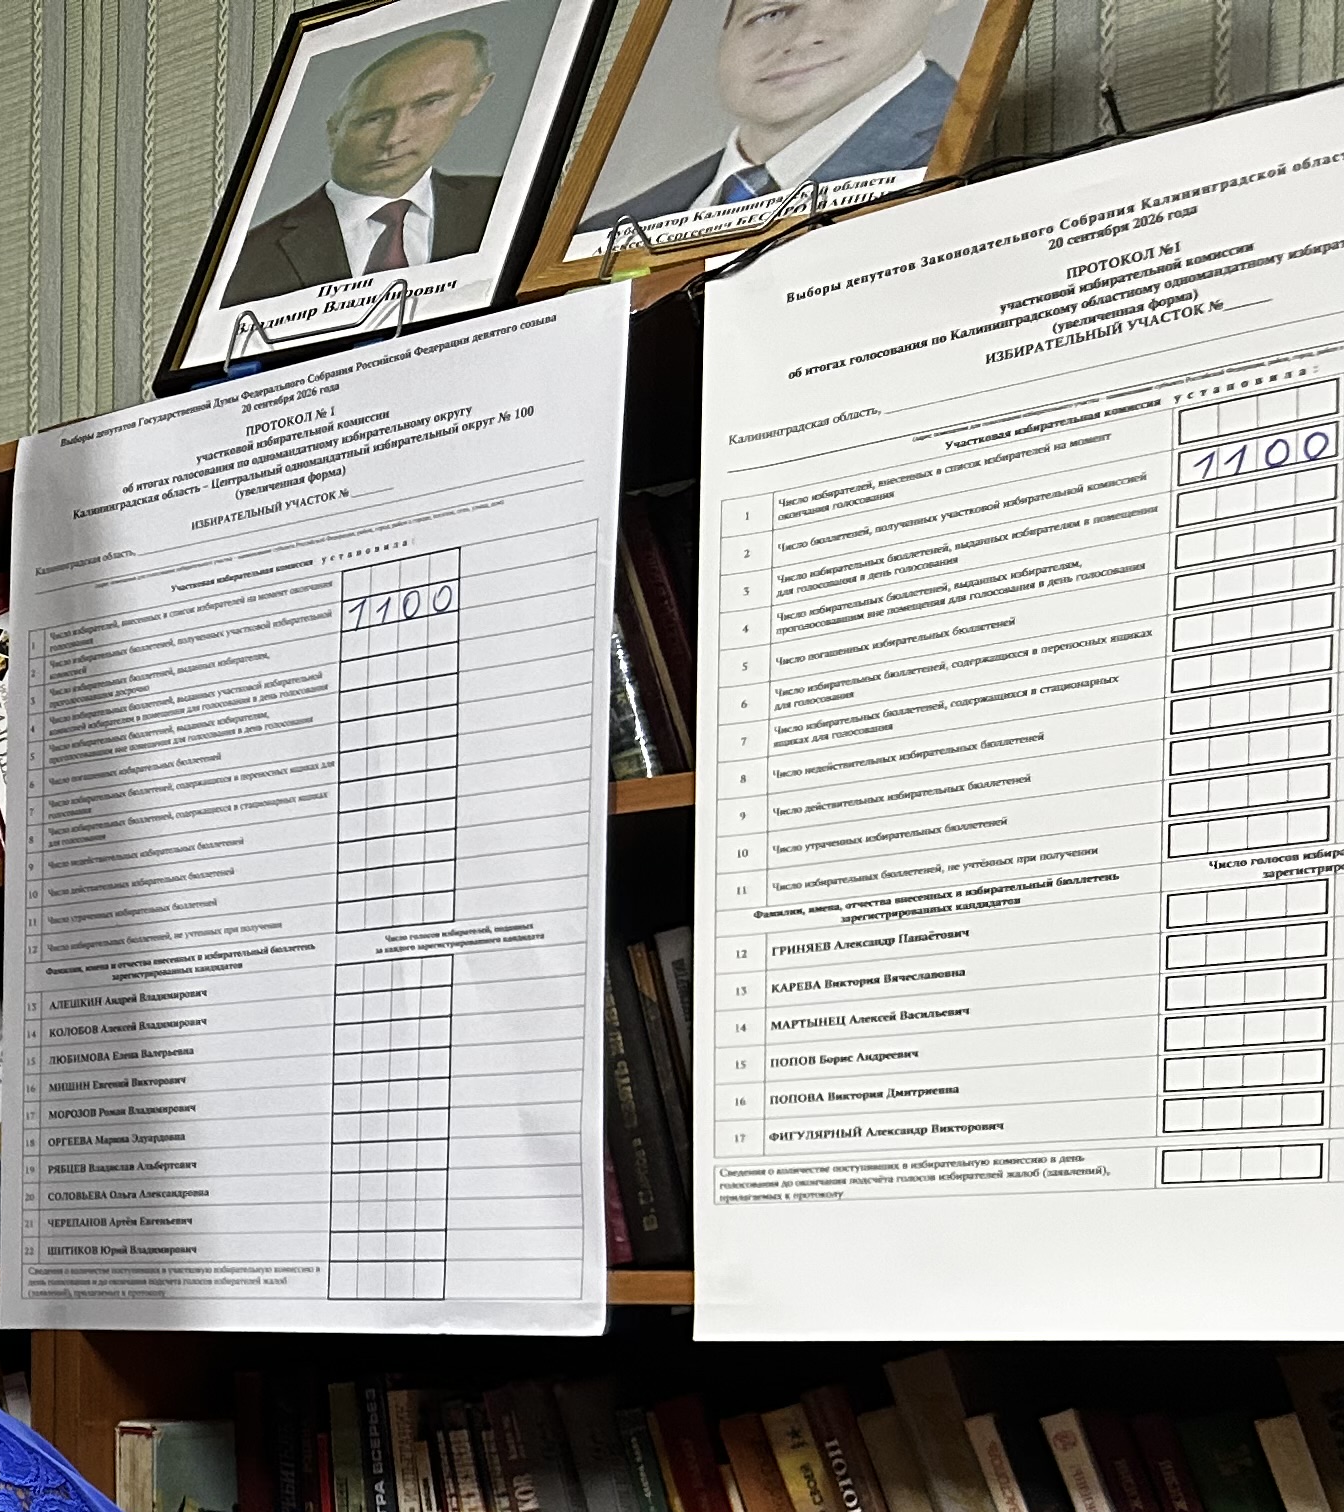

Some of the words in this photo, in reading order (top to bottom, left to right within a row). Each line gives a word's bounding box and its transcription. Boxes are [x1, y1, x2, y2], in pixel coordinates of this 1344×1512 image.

[786, 281, 841, 303] Выборы
[845, 262, 916, 289] депутатов
[920, 225, 1054, 267] Законодательного
[1059, 204, 1135, 230] Собрания
[1140, 162, 1286, 210] Калининградской
[1047, 236, 1063, 250] 20
[1066, 222, 1130, 245] сентября
[1132, 210, 1164, 229] 2026
[1167, 205, 1197, 220] года
[316, 277, 374, 299] Путин
[999, 282, 1075, 315] участковой
[1078, 257, 1182, 293] избирательной
[1185, 242, 1254, 267] комиссии
[787, 366, 802, 379] об
[804, 358, 846, 375] итогах
[849, 338, 928, 365] голосования
[931, 335, 947, 345] по
[950, 302, 1078, 340] Калининградскому
[1080, 282, 1161, 308] областному
[1163, 252, 1284, 288] одномандатному
[985, 320, 1122, 364] ИЗБИРАТЕЛЬНЫЙ
[1126, 302, 1204, 330] УЧАСТОК
[1207, 299, 1223, 312] №
[1052, 303, 1144, 334] (увеличенная
[1147, 288, 1198, 311] форма)
[195, 439, 254, 466] участковой
[255, 420, 334, 449] избирательной
[336, 410, 389, 430] комиссии
[245, 410, 312, 436] ПРОТОКОЛ
[314, 407, 327, 420] №
[330, 405, 334, 416] 1
[121, 482, 134, 494] об
[135, 476, 169, 491] итогах
[171, 462, 235, 483] голосования
[236, 459, 249, 468] по
[251, 437, 339, 465] одномандатному
[341, 415, 431, 444] избирательному
[433, 405, 472, 422] округу
[1194, 430, 1330, 480] 1100
[234, 475, 305, 500] (увеличенная
[307, 464, 346, 484] форма)
[191, 500, 282, 530] ИЗБИРАТЕЛЬНЫЙ
[284, 489, 336, 510] УЧАСТОК
[337, 487, 349, 498] №
[349, 585, 452, 631] 1100
